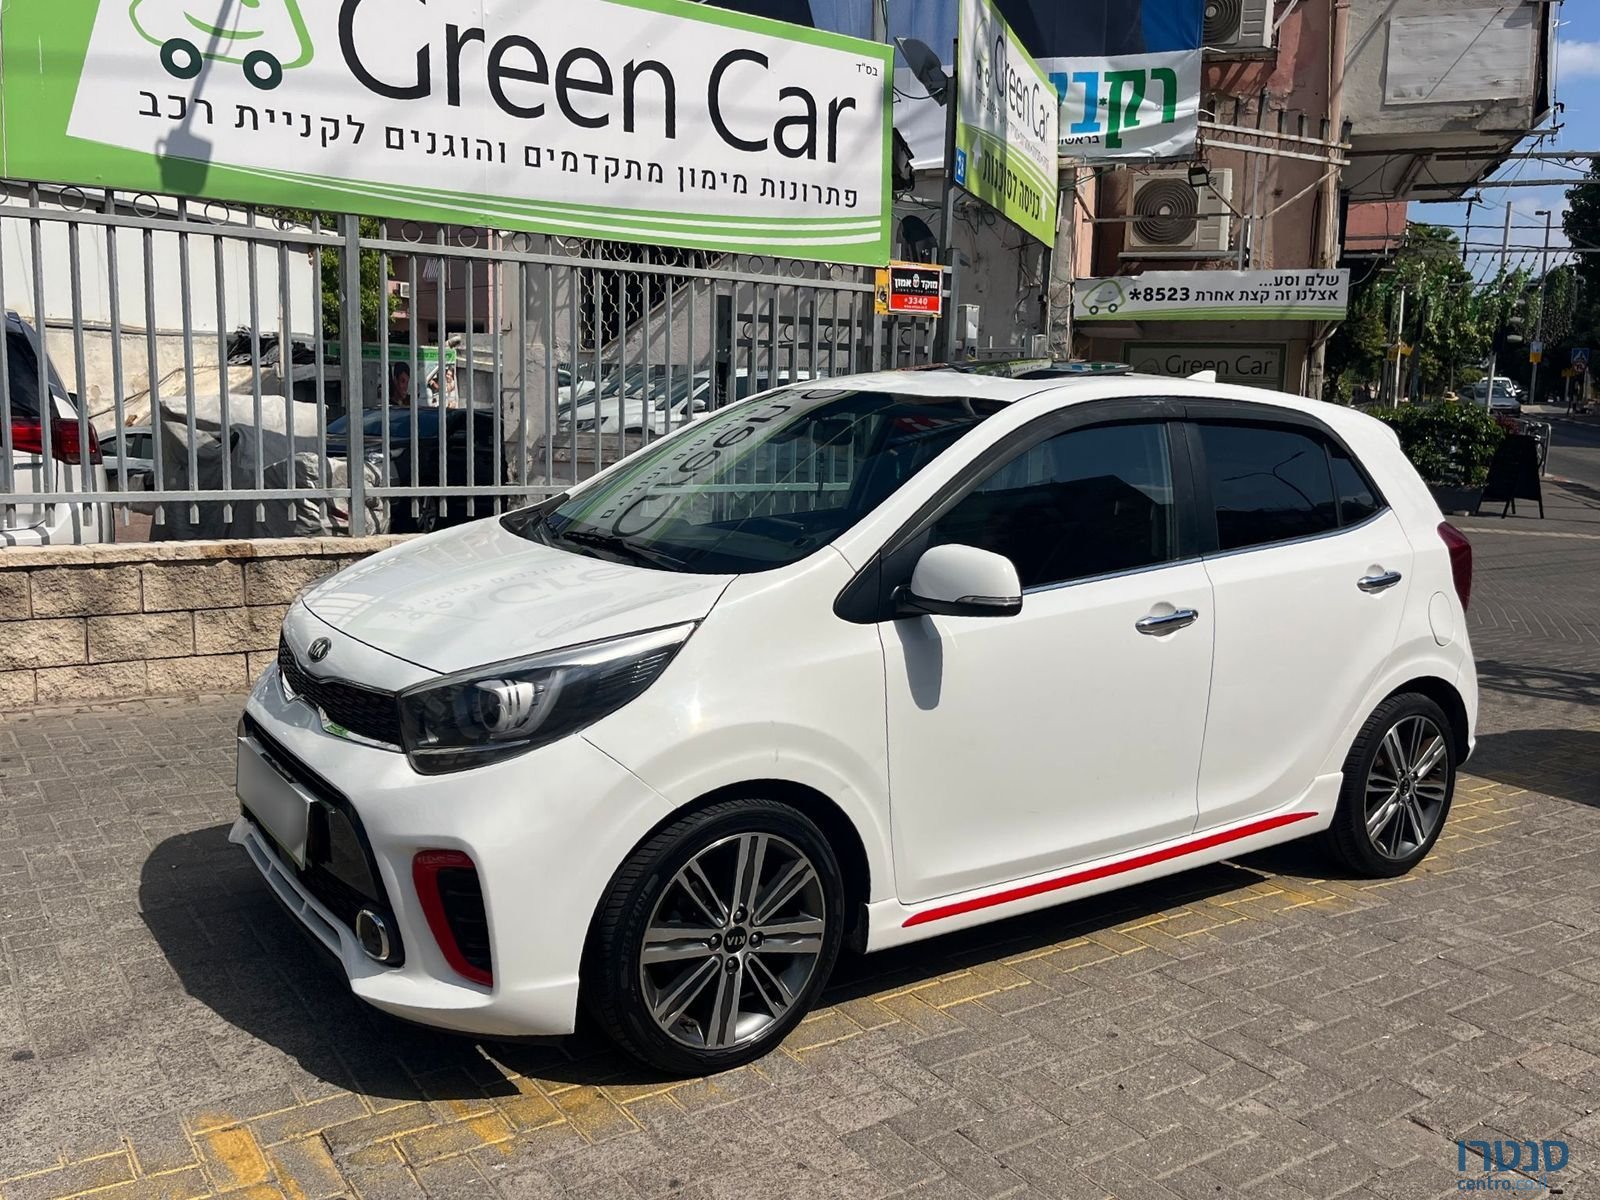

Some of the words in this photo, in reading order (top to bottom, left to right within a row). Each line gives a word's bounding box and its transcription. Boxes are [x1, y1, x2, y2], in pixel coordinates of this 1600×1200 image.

[338, 0, 676, 139] Green
[708, 48, 856, 163] Car
[856, 63, 878, 76] בס"ד
[995, 34, 1029, 128] Green
[1032, 83, 1049, 142] Car
[139, 90, 214, 125] רכב
[235, 103, 366, 148] לקניית
[385, 126, 507, 164] והוגנים
[524, 145, 664, 184] מתקדמים
[678, 165, 748, 194] מימון
[760, 178, 858, 208] פתרונות
[1019, 180, 1040, 221] כניסה
[1295, 288, 1338, 301] אצלנו
[1305, 273, 1340, 287] שלם
[1195, 290, 1234, 302] אחרת
[1239, 290, 1270, 304] קצת
[1275, 290, 1291, 301] זה
[1165, 354, 1229, 375] Green
[1235, 355, 1272, 375] Car
[727, 934, 746, 946] KIA
